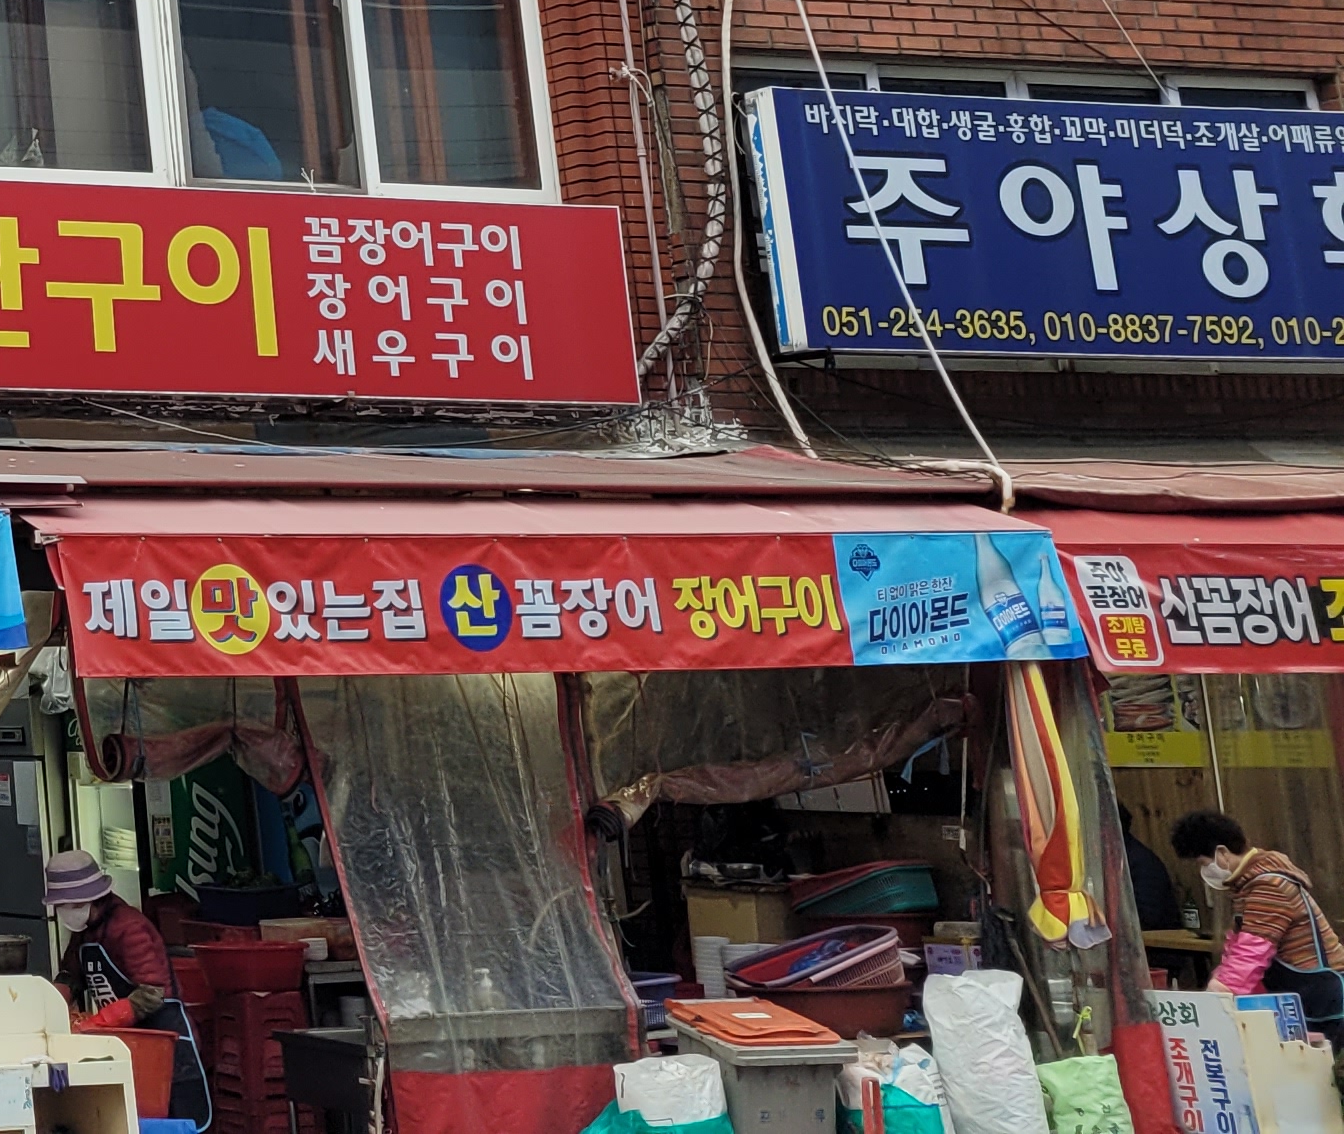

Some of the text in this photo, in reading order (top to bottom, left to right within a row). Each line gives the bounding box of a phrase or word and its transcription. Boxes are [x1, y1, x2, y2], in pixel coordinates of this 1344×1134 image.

[303, 217, 523, 270] 꼼장어구이
[1085, 559, 1131, 584] 주야
[672, 572, 843, 641] 장어구이
[868, 592, 971, 644] 다이아몬드
[1159, 576, 1316, 646] 산꼼장어
[1107, 616, 1147, 636] 조개탕
[880, 632, 962, 656] DIAMOND
[1115, 637, 1149, 659] 무료
[1154, 1000, 1200, 1028] 상회
